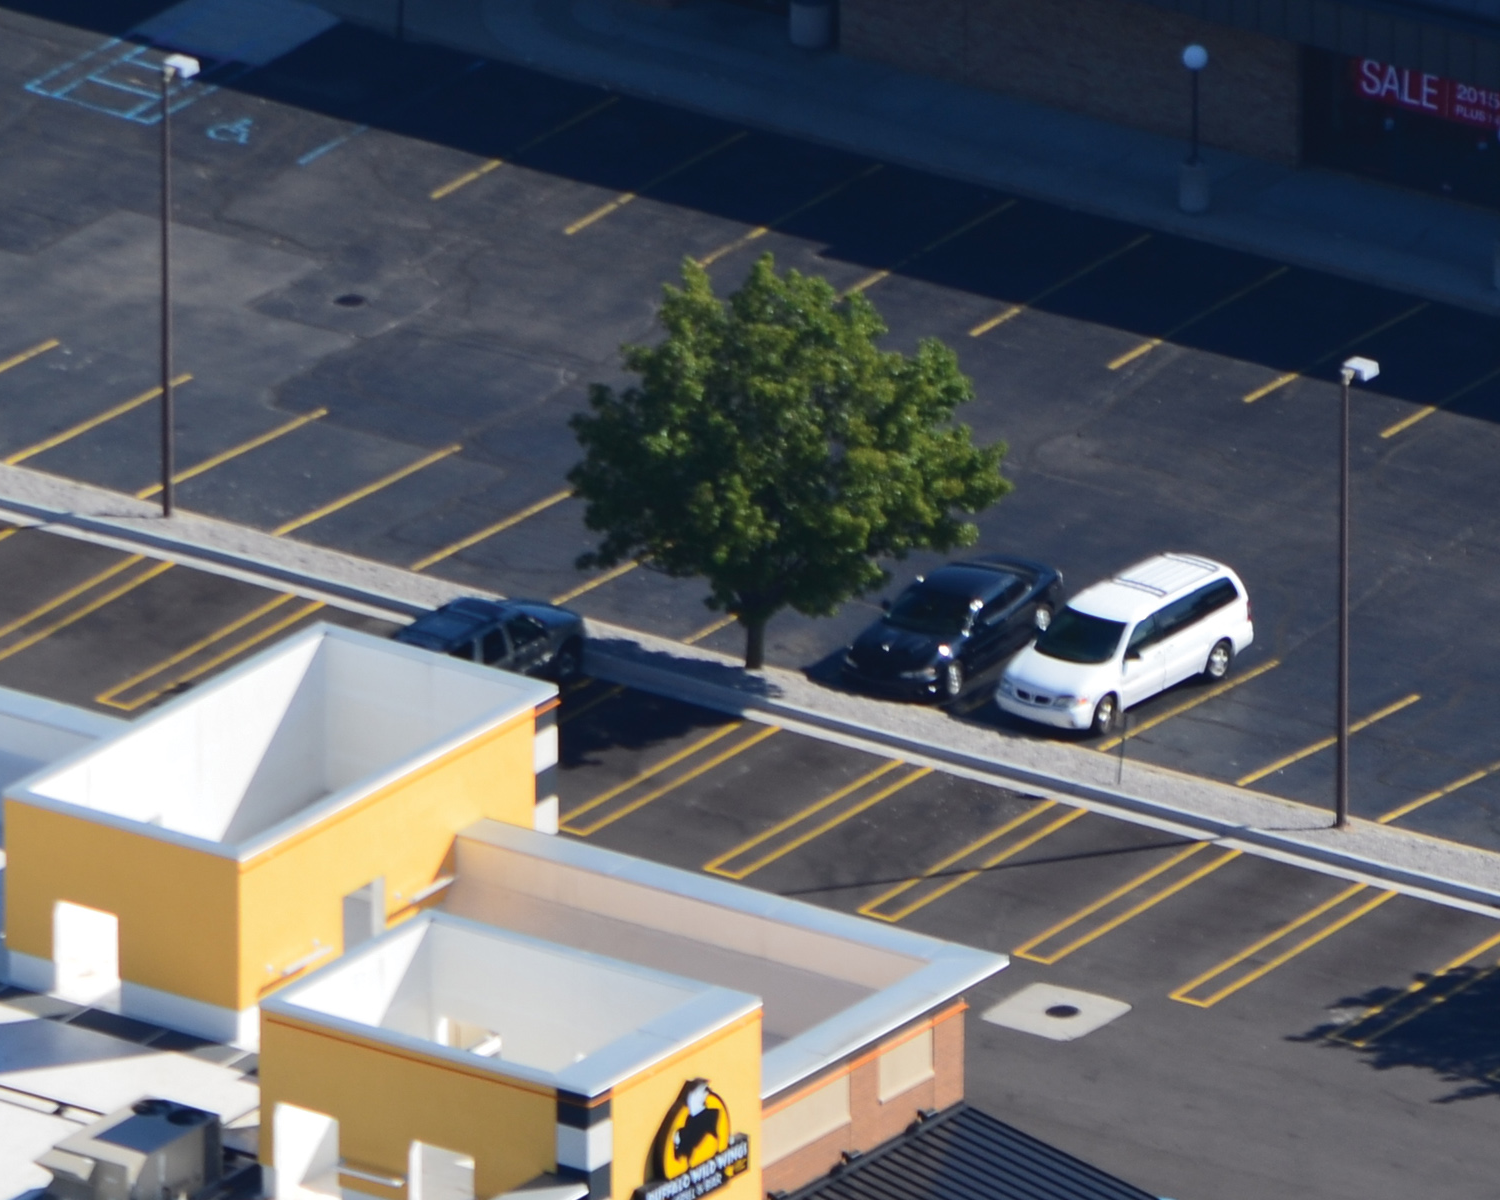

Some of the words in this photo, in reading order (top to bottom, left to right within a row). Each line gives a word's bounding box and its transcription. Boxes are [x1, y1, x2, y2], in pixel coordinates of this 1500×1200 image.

[1361, 59, 1440, 110] SALE
[1455, 104, 1487, 123] PLUS
[689, 1159, 717, 1184] WILD
